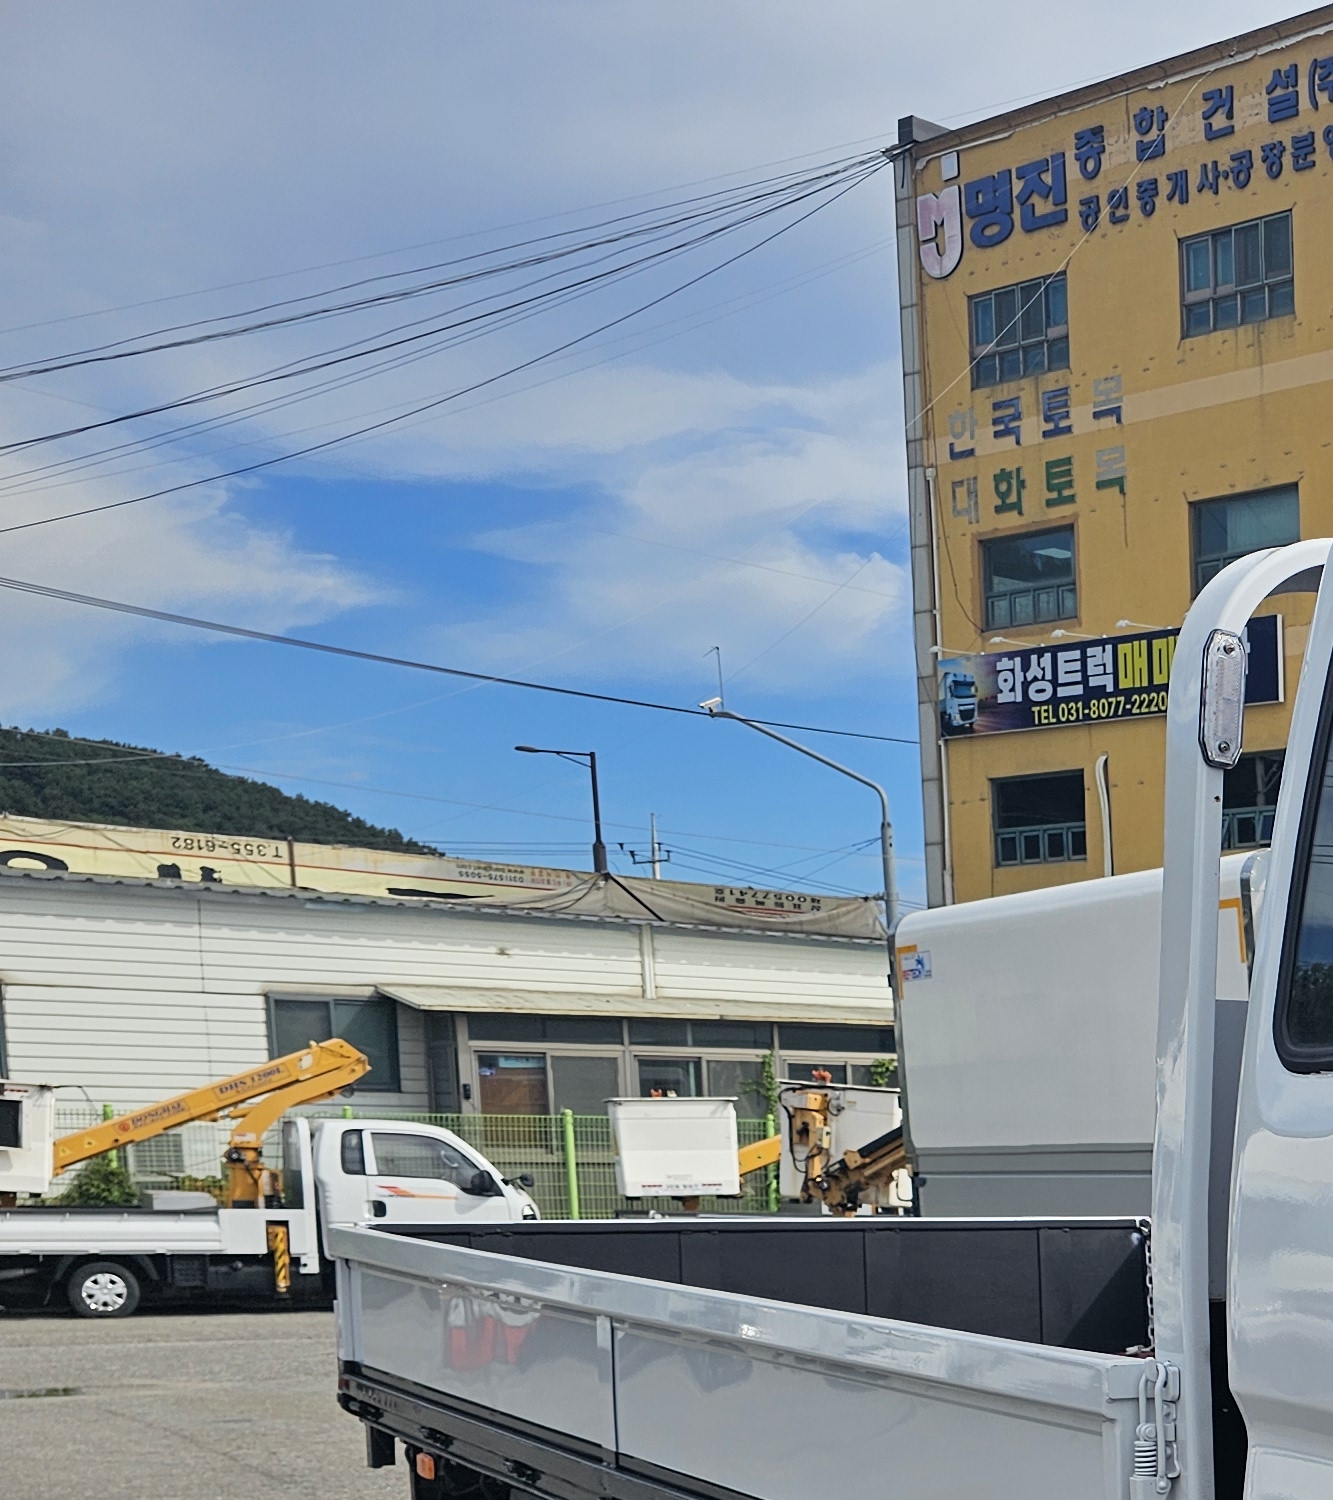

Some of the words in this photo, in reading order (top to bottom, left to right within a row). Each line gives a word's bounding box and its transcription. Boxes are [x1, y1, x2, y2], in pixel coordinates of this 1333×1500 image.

[996, 643, 1114, 704] 화성트럭
[1031, 705, 1057, 725] TEL
[1058, 691, 1168, 722] 031-8077-2220
